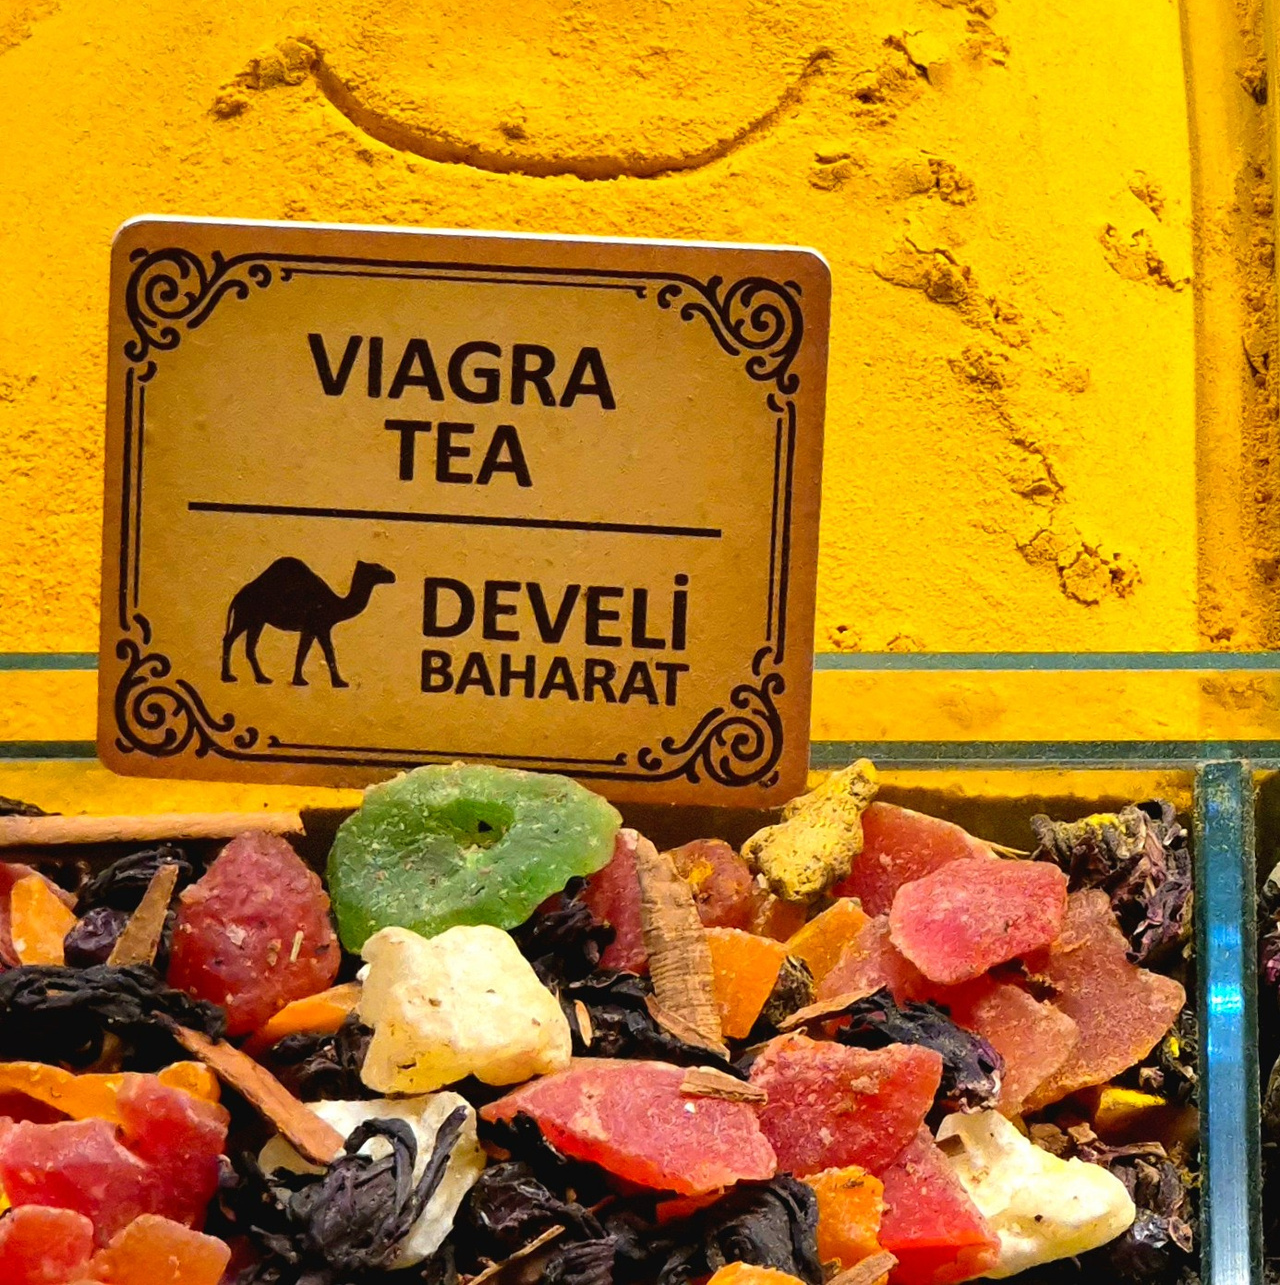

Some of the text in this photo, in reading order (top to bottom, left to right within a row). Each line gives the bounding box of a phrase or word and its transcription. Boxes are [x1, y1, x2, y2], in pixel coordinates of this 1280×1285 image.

[307, 332, 616, 410] VIAGRA
[384, 419, 533, 487] TEA
[420, 651, 689, 706] BAHARAT
